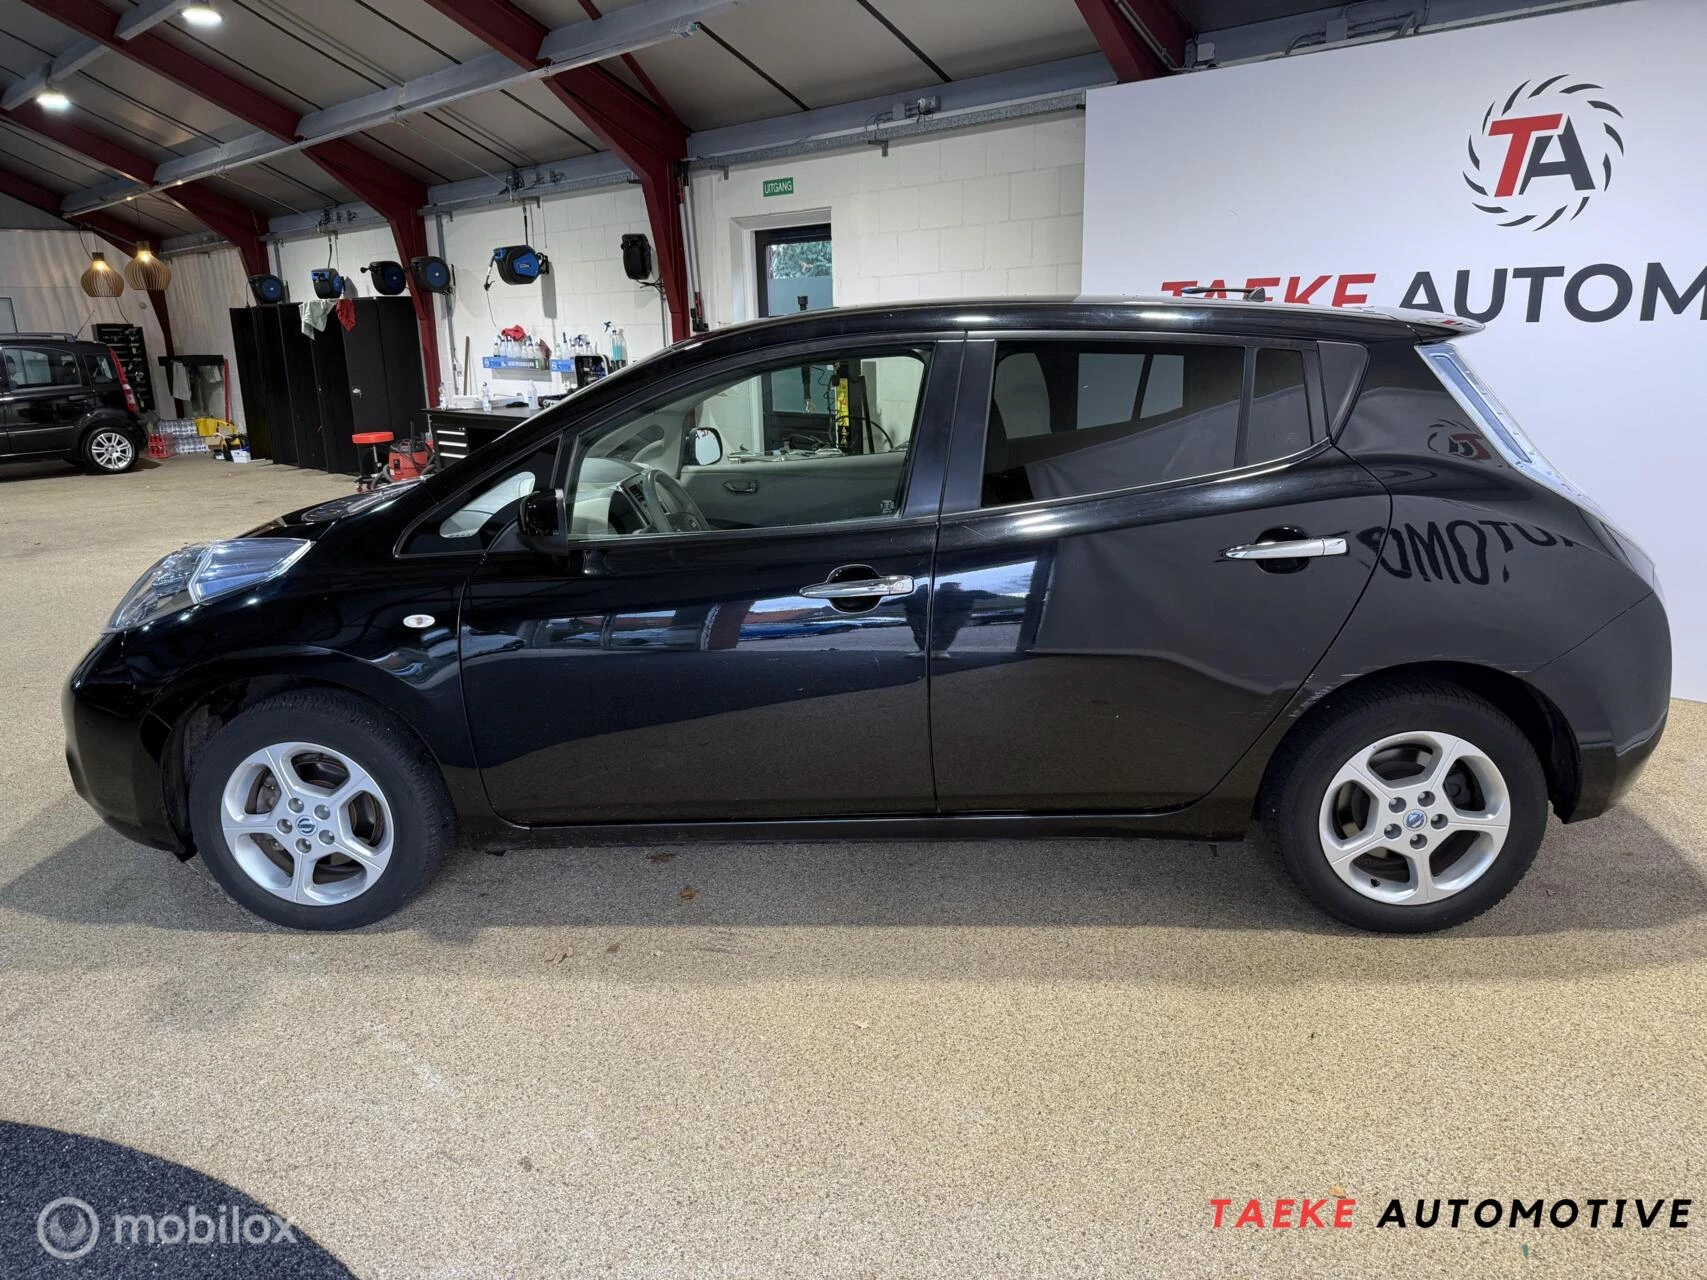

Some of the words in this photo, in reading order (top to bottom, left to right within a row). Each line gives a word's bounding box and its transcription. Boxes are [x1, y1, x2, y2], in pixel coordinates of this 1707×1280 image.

[1488, 113, 1596, 198] TA
[764, 180, 793, 193] UITGANG
[1399, 262, 1707, 323] AUTOM
